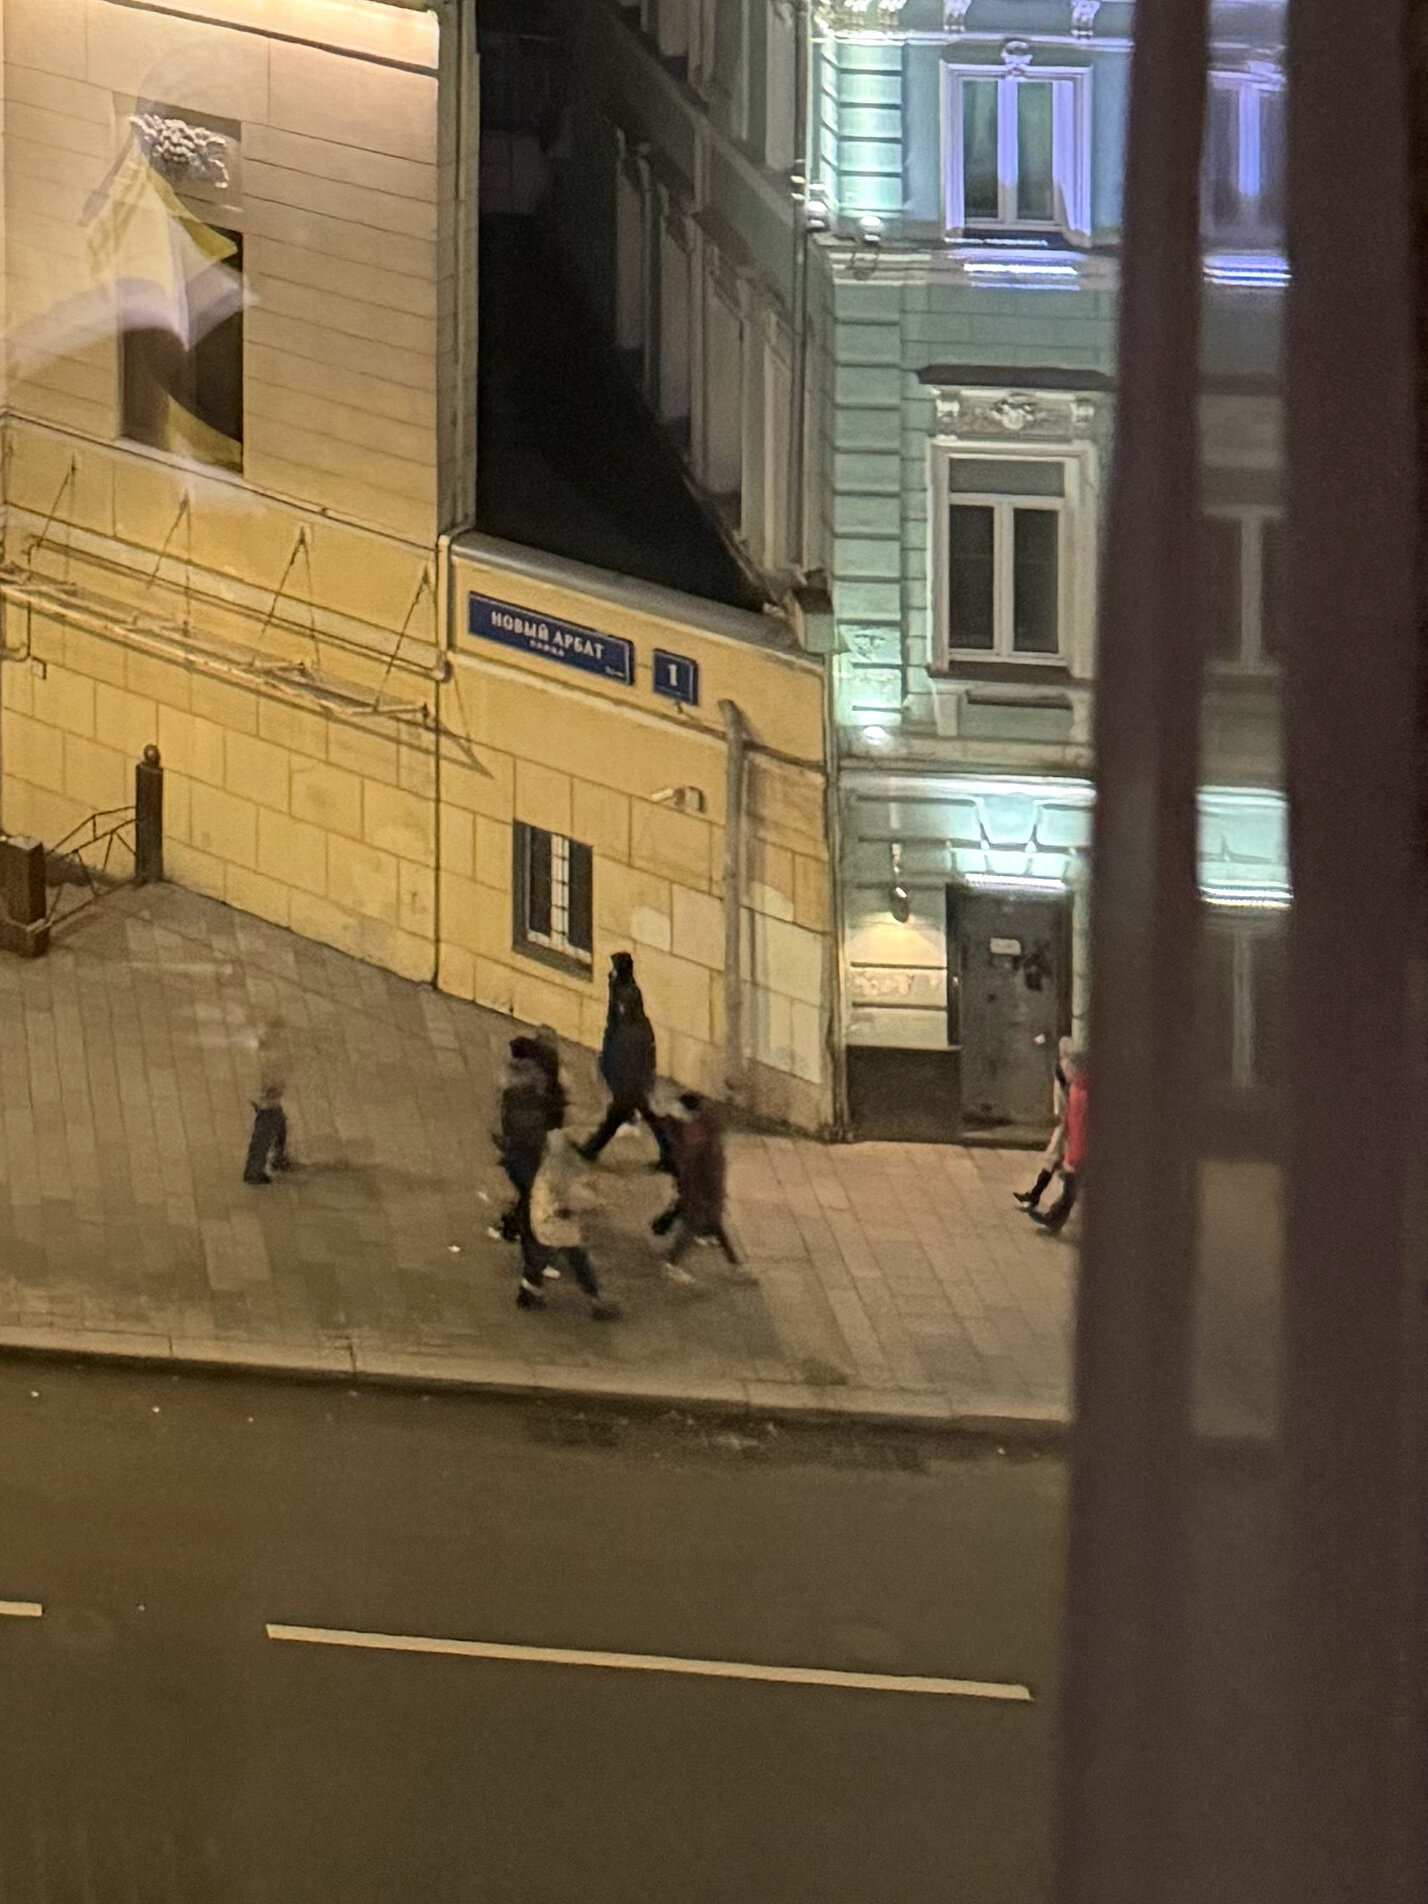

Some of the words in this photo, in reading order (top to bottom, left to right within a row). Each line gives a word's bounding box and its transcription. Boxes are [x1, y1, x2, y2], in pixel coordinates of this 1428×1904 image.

[491, 611, 549, 641] НОВЫЙ
[552, 631, 604, 659] АРБАТ
[667, 664, 678, 687] 1
